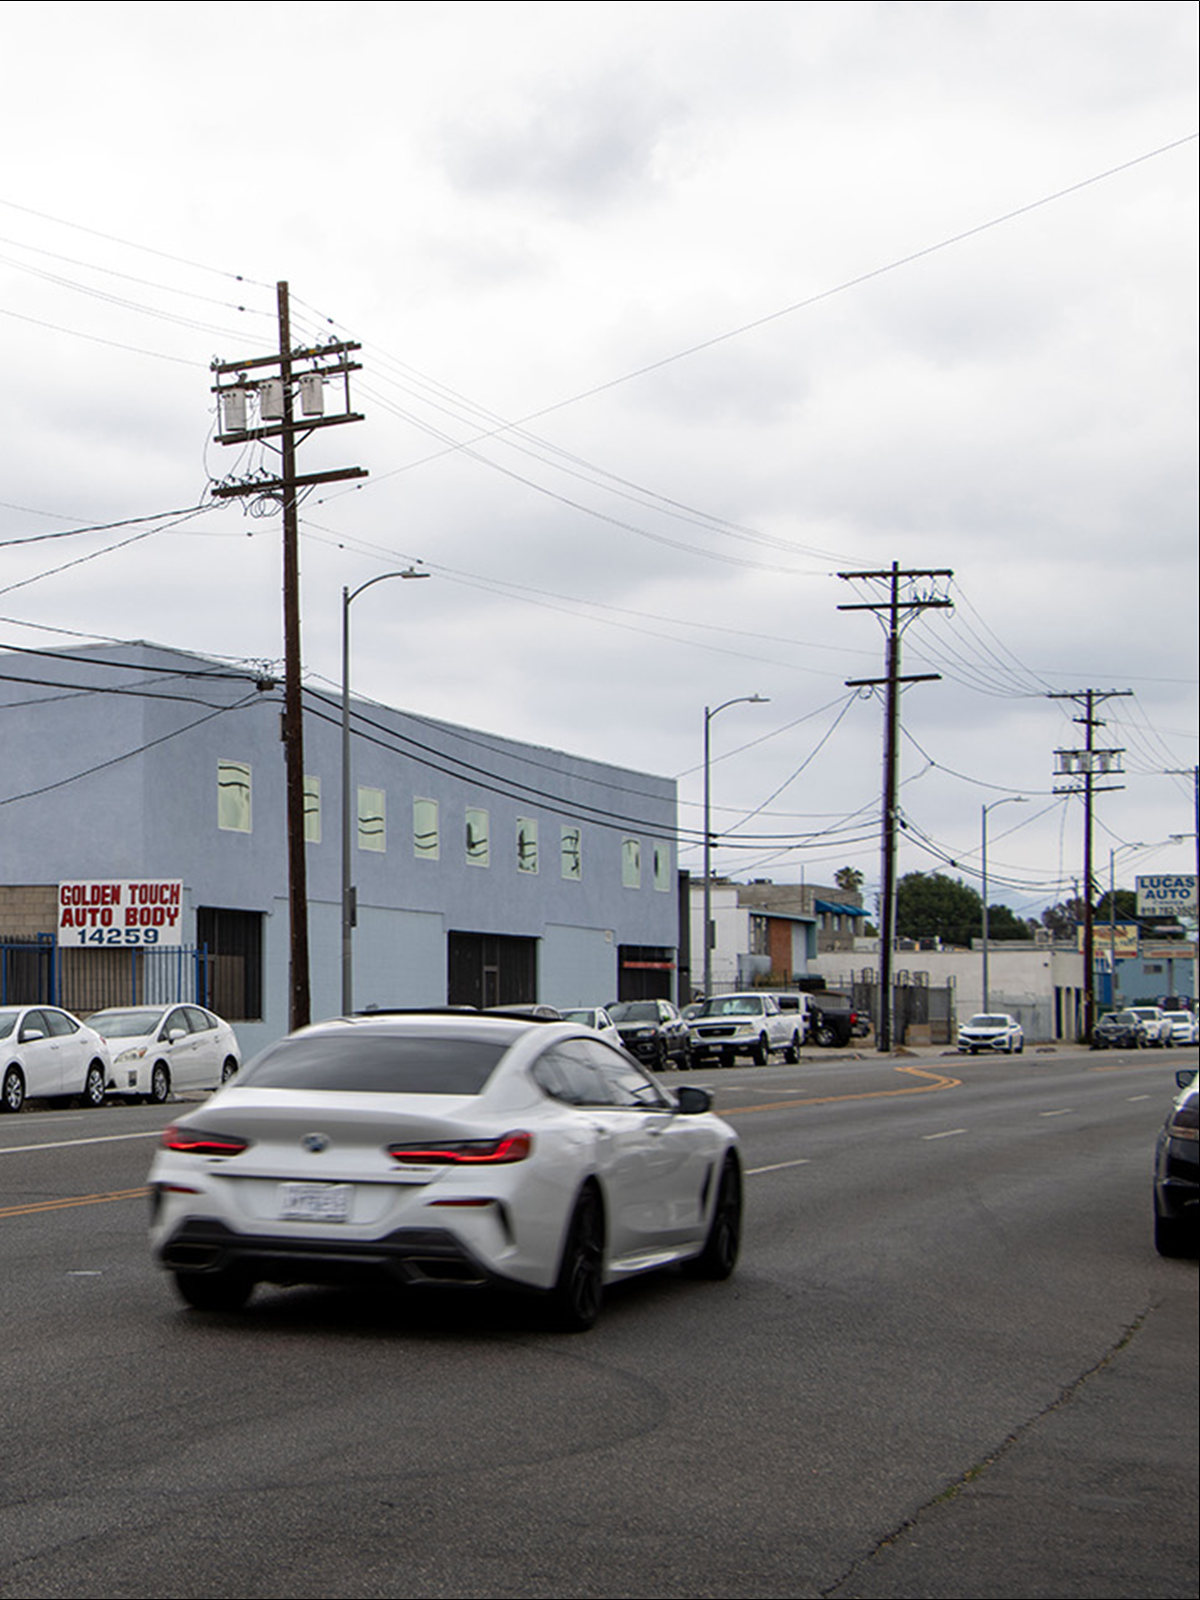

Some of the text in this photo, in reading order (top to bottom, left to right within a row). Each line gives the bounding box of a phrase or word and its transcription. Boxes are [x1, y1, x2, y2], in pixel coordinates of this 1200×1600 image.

[1140, 878, 1195, 888] LUCAS
[60, 883, 181, 906] GOLDEN TOUCH
[1144, 889, 1191, 899] AUTO
[60, 907, 180, 928] AUTO BODY
[77, 928, 159, 945] 14259
